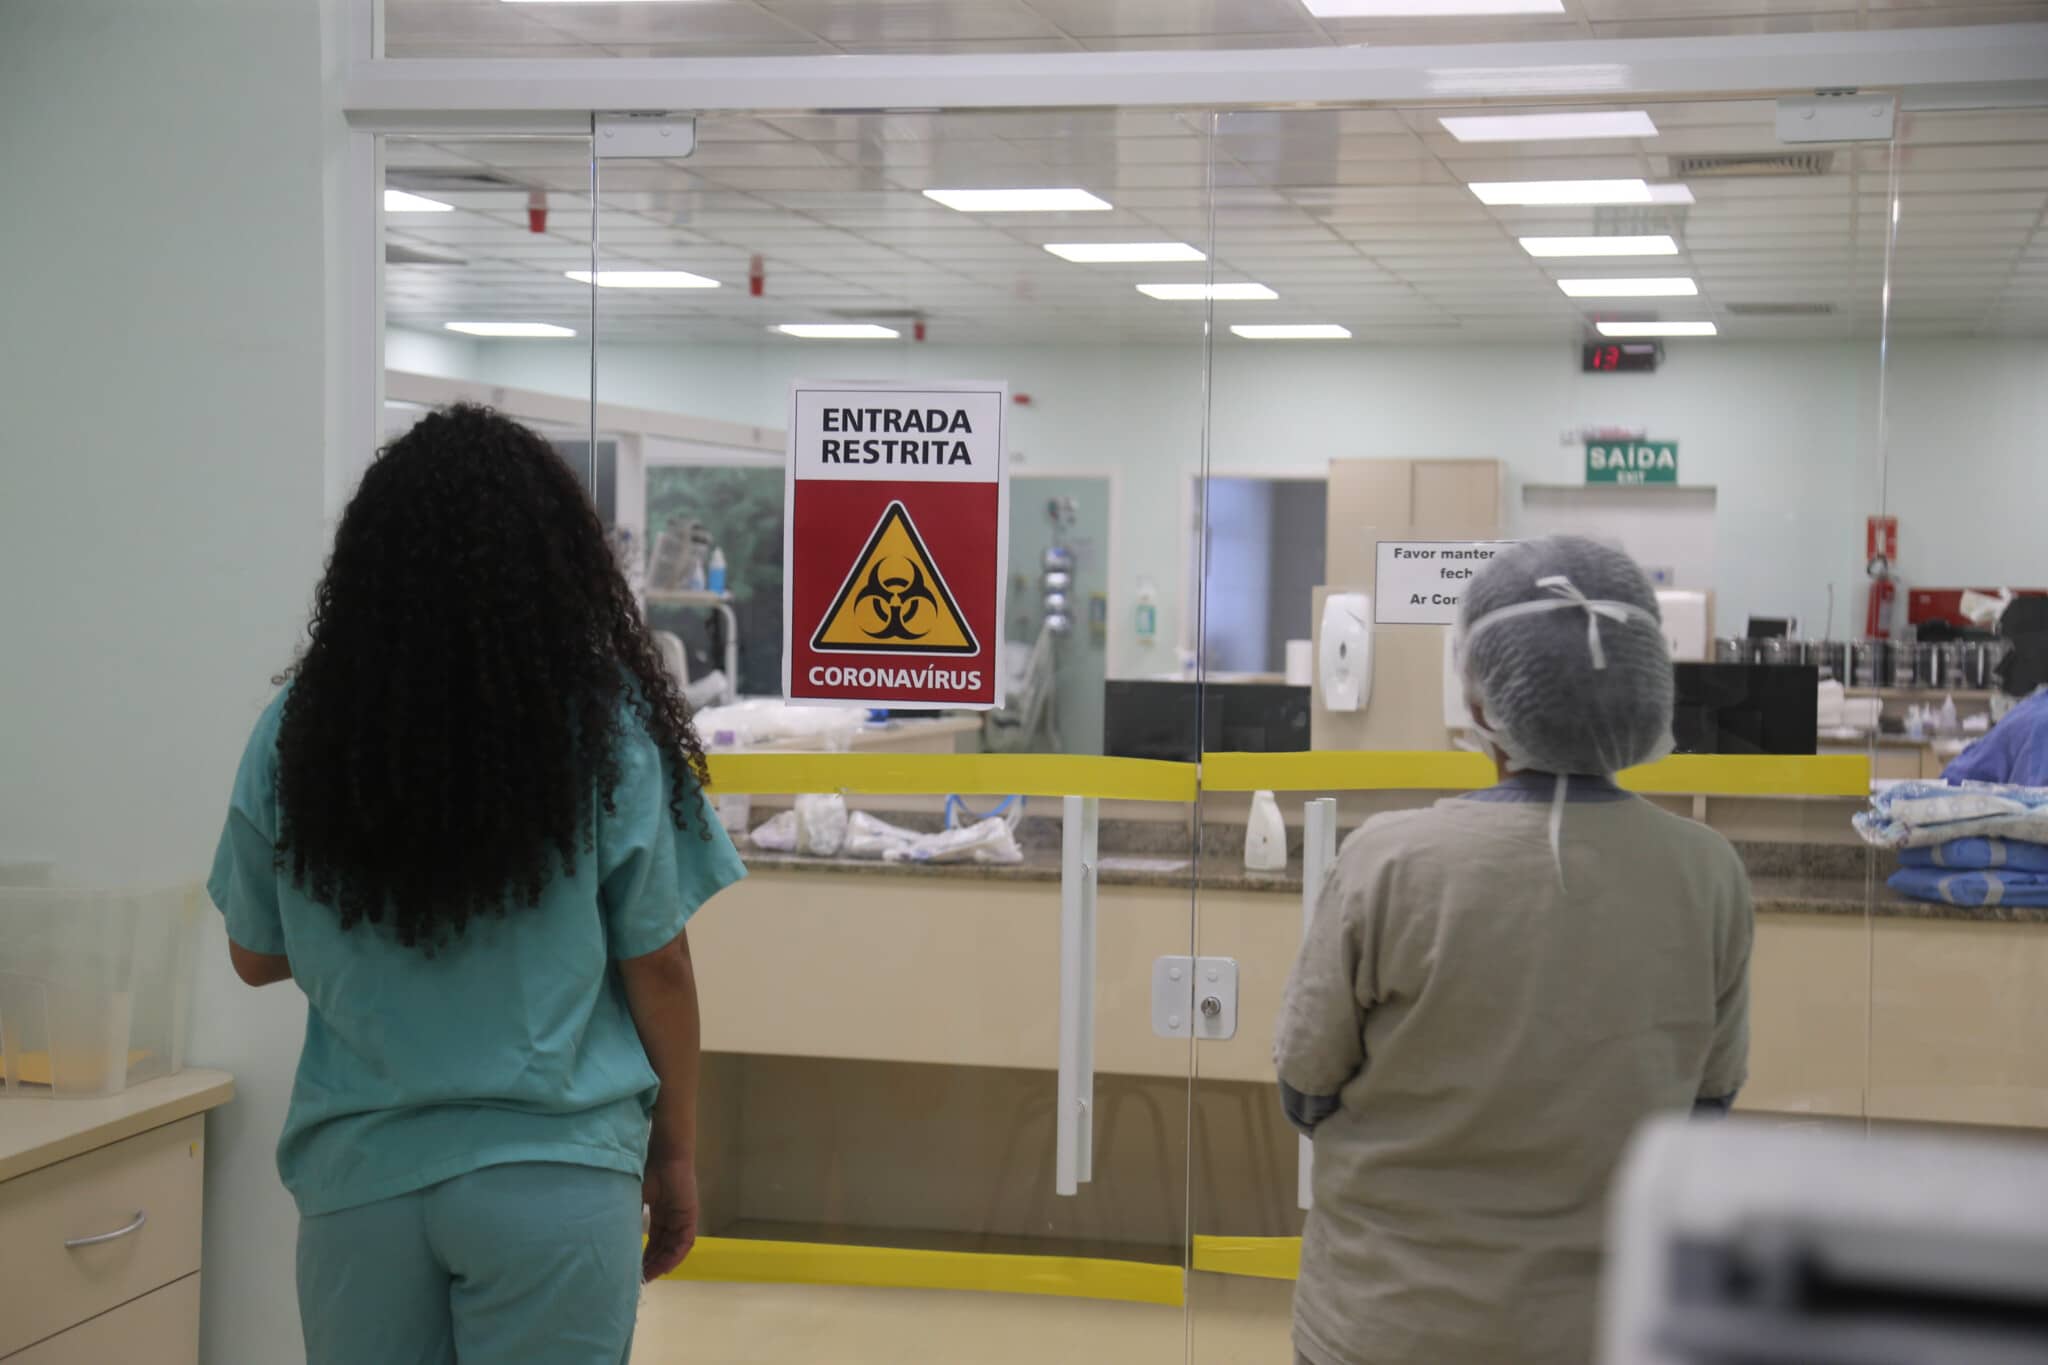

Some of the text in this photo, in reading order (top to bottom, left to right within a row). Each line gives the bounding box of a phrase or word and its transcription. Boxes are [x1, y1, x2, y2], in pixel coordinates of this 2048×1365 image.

[822, 408, 972, 433] ENTRADA
[821, 439, 972, 465] RESTRITA
[1589, 443, 1675, 470] SAÍDA
[1394, 548, 1496, 559] Favor manter
[1410, 594, 1427, 605] Ar
[808, 664, 981, 690] CORONAVÍRUS
